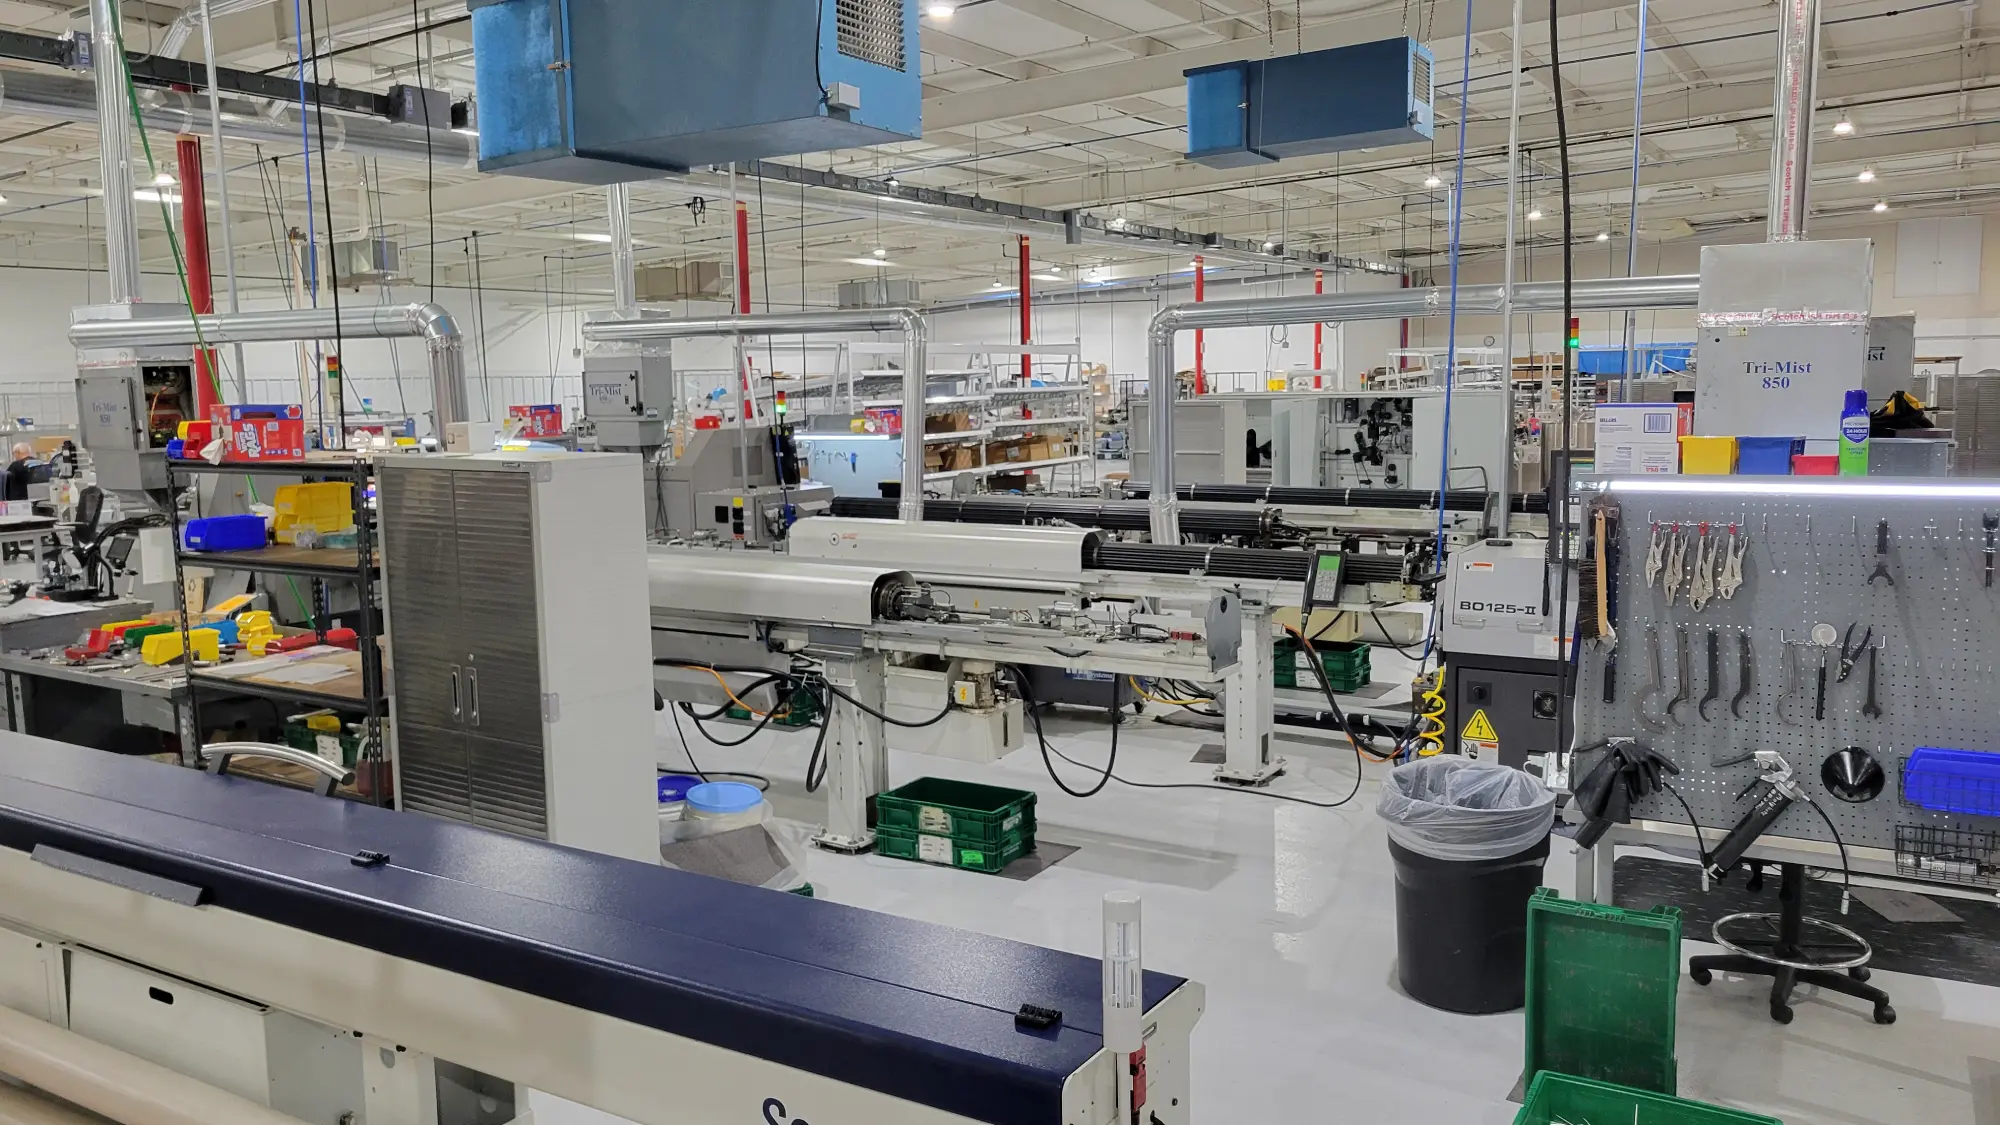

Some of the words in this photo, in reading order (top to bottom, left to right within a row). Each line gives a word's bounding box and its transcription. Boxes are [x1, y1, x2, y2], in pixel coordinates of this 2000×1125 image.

[1742, 361, 1812, 374] Tri-Mist
[1762, 376, 1790, 389] 850
[242, 423, 261, 458] RAGS
